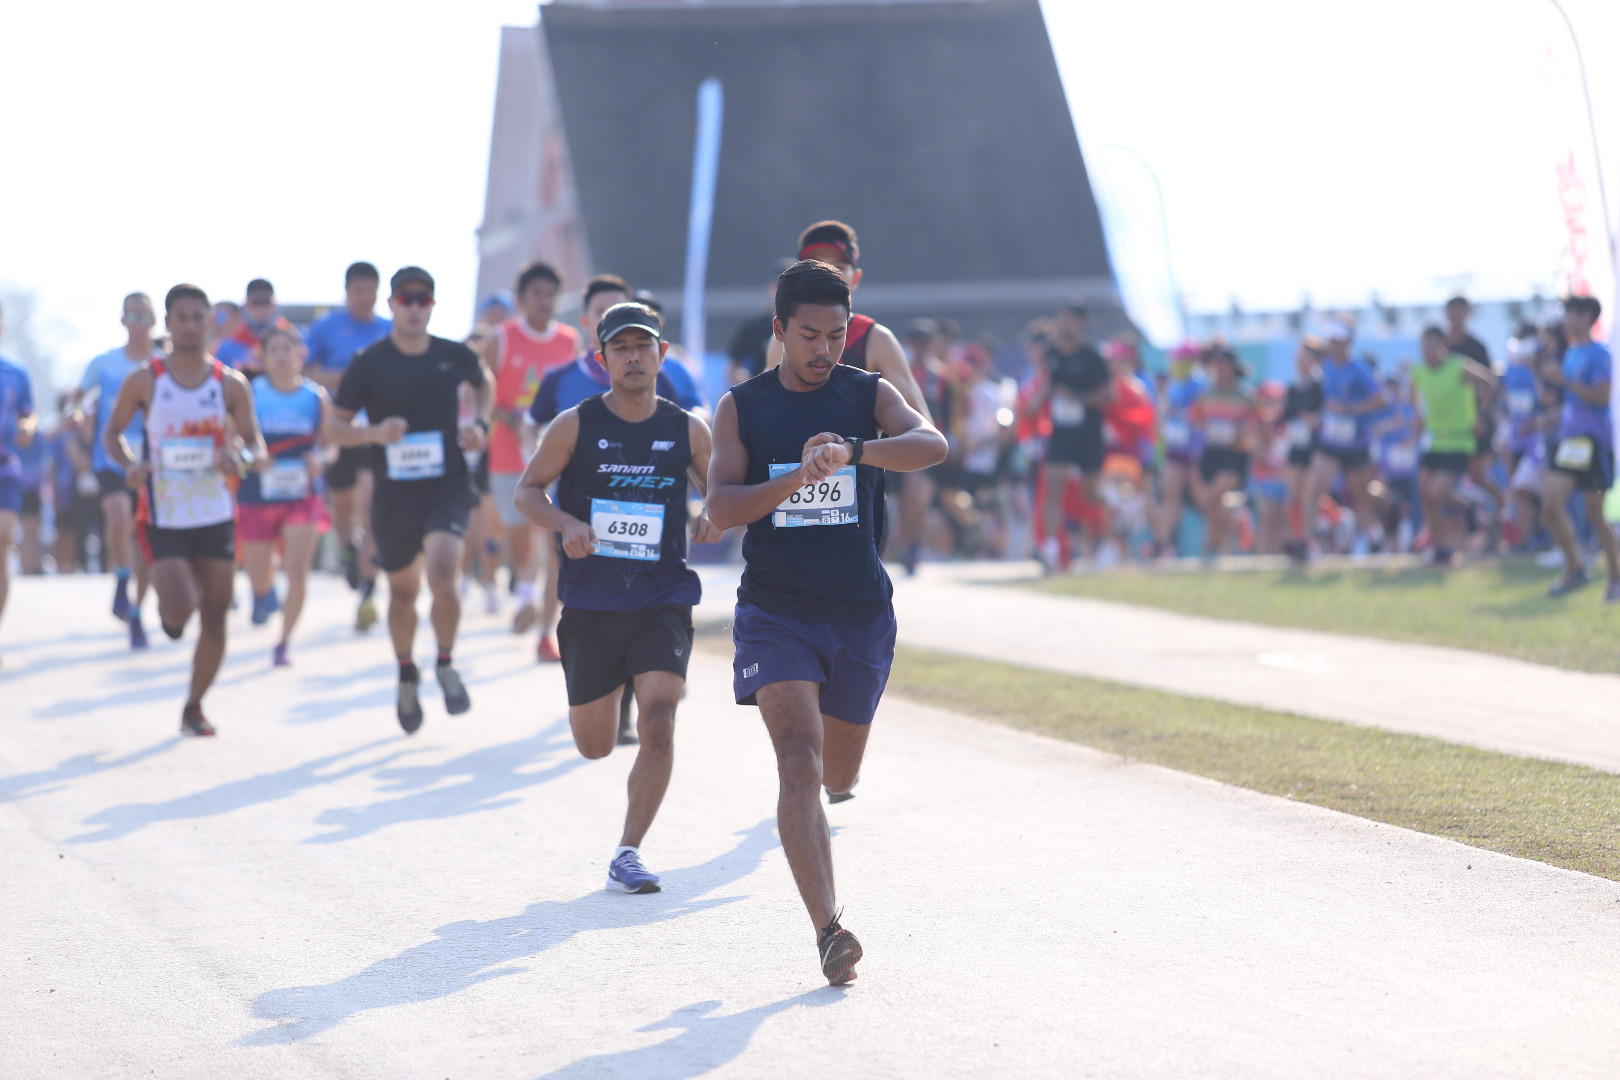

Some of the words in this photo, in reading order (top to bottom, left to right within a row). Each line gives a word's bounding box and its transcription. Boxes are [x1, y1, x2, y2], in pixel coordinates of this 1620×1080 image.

[608, 475, 676, 489] THEP
[789, 481, 842, 504] 6396
[840, 512, 850, 522] 16
[608, 521, 648, 537] 6308
